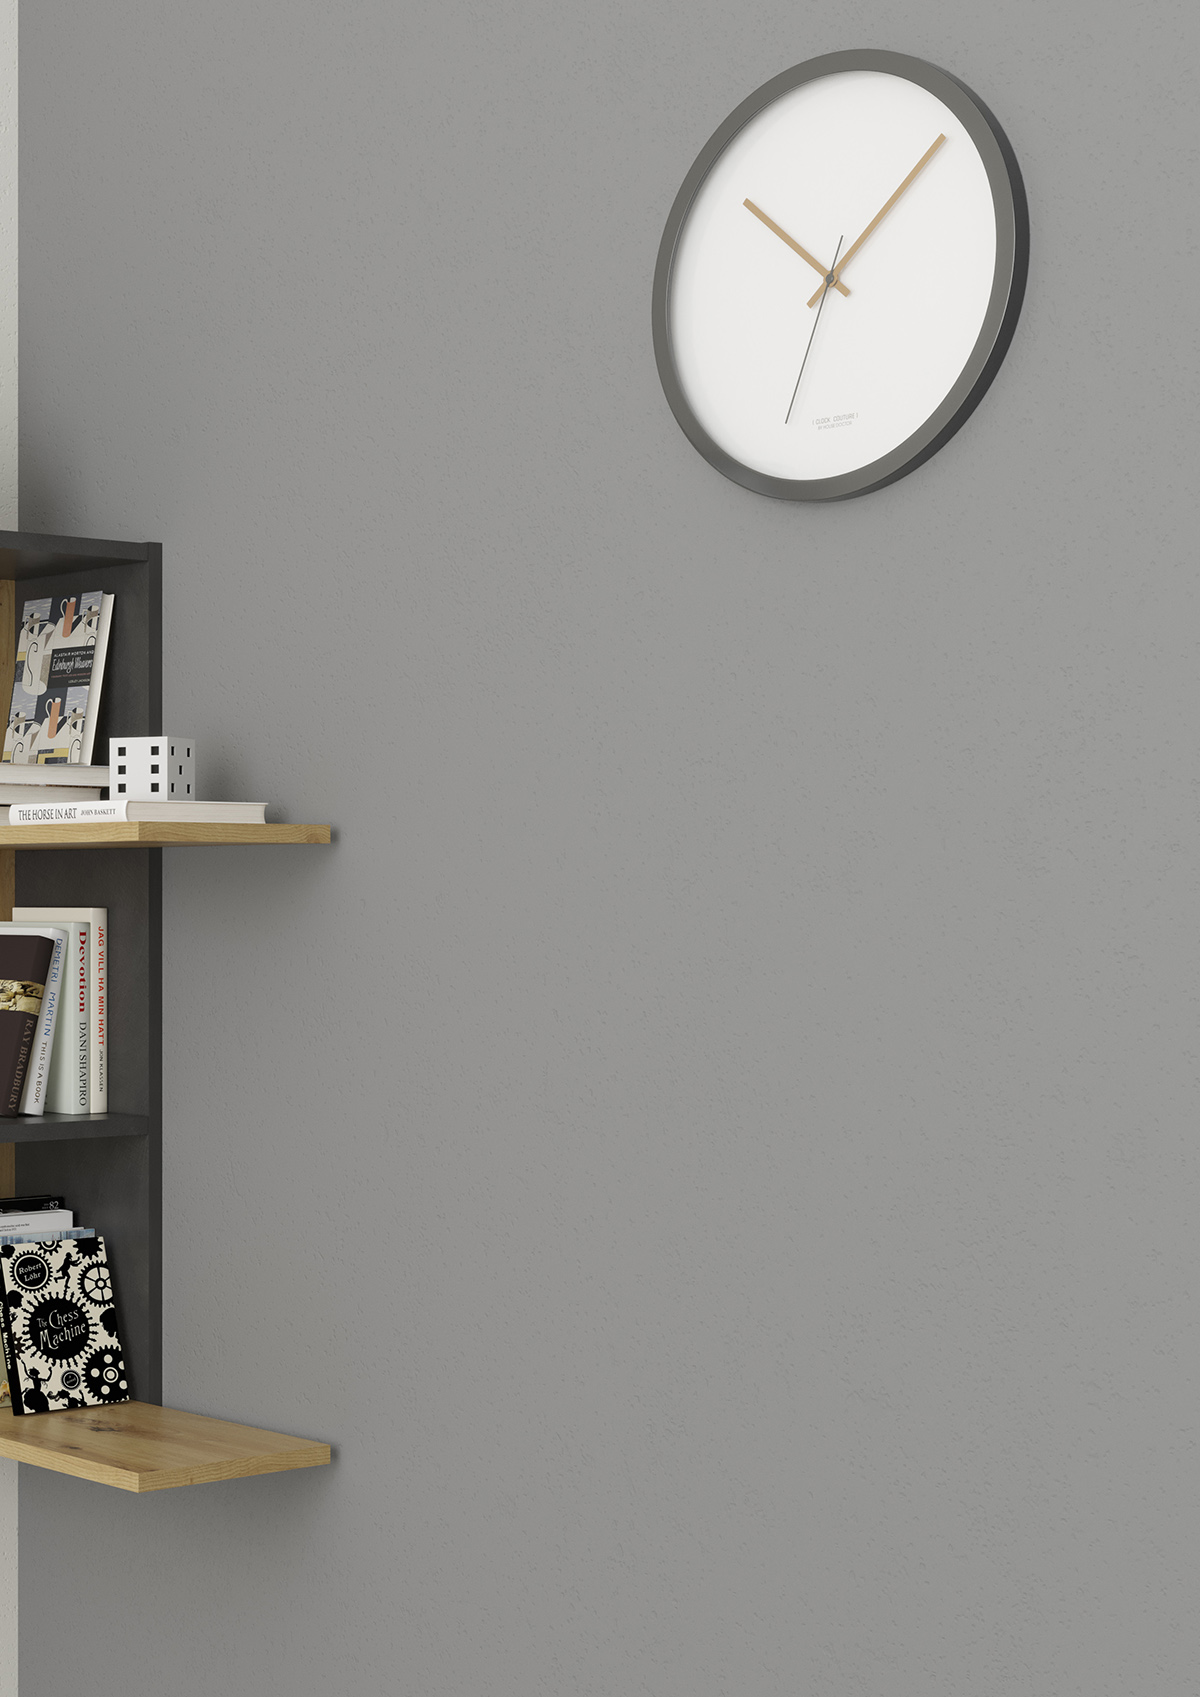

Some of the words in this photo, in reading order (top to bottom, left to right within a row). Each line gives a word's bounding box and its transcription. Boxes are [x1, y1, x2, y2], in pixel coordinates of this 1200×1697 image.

[52, 658, 74, 673] Edinburgh
[74, 657, 93, 668] Weavers
[18, 809, 31, 821] THE
[32, 808, 54, 820] HORSE
[55, 808, 63, 819] IN
[64, 807, 77, 819] ART
[50, 938, 64, 983] DEMETRI
[79, 931, 87, 1013] Devotion
[98, 977, 105, 992] HA
[43, 991, 56, 1037] MARTIN
[22, 1018, 34, 1045] RAY
[79, 1022, 87, 1052] DANI
[40, 1041, 48, 1061] THIS
[8, 1046, 28, 1112] BRADBURY
[38, 1063, 45, 1071] IS
[33, 1080, 43, 1104] BOOK
[79, 1054, 87, 1107] SHAPIRO
[18, 1261, 42, 1275] Robert
[23, 1271, 42, 1283] Löhr
[36, 1317, 48, 1329] The
[48, 1309, 79, 1330] Chess
[39, 1322, 87, 1351] Machine
[2, 1331, 12, 1370] Machine
